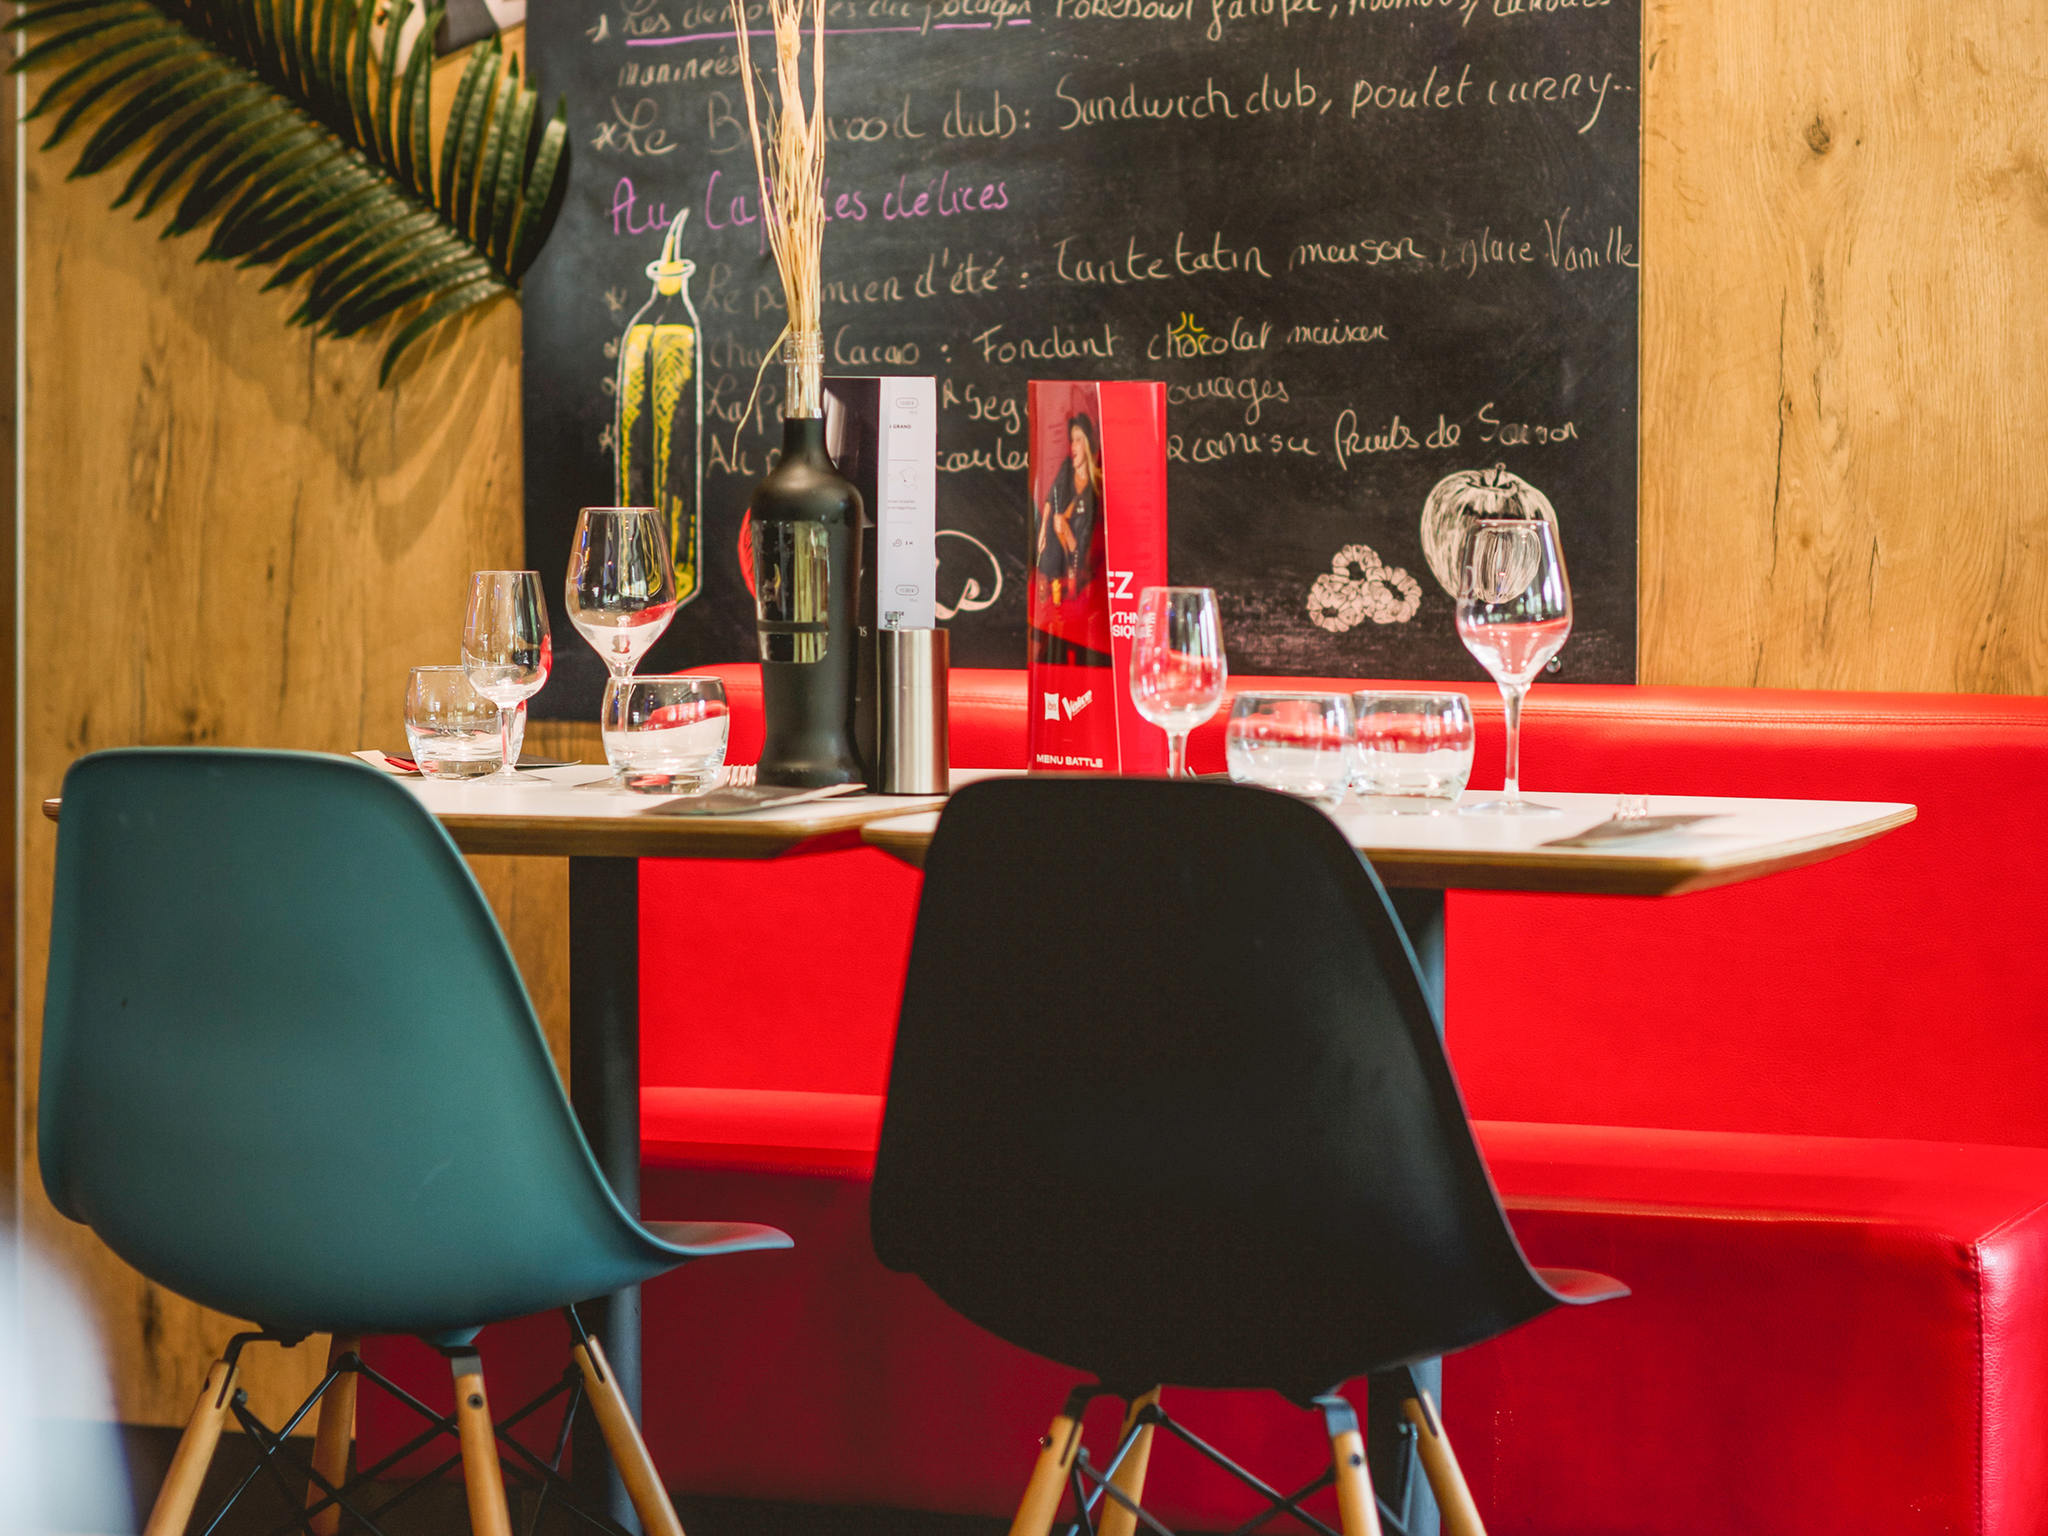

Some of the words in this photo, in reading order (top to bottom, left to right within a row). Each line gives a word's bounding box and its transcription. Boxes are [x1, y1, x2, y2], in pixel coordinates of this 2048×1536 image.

[1056, 73, 1239, 131] Sandwich
[1352, 64, 1472, 118] poulet
[611, 177, 674, 236] Au
[883, 169, 1010, 222] délices
[914, 247, 1005, 299] d'été
[1545, 206, 1640, 272] Vanille
[833, 324, 920, 366] Cacao
[972, 323, 1124, 364] Fondant
[1147, 315, 1273, 361] chocolat
[1425, 413, 1462, 449] de
[1478, 402, 1579, 445] Saison
[1036, 753, 1064, 766] MENU
[1065, 756, 1104, 769] BATTLE
